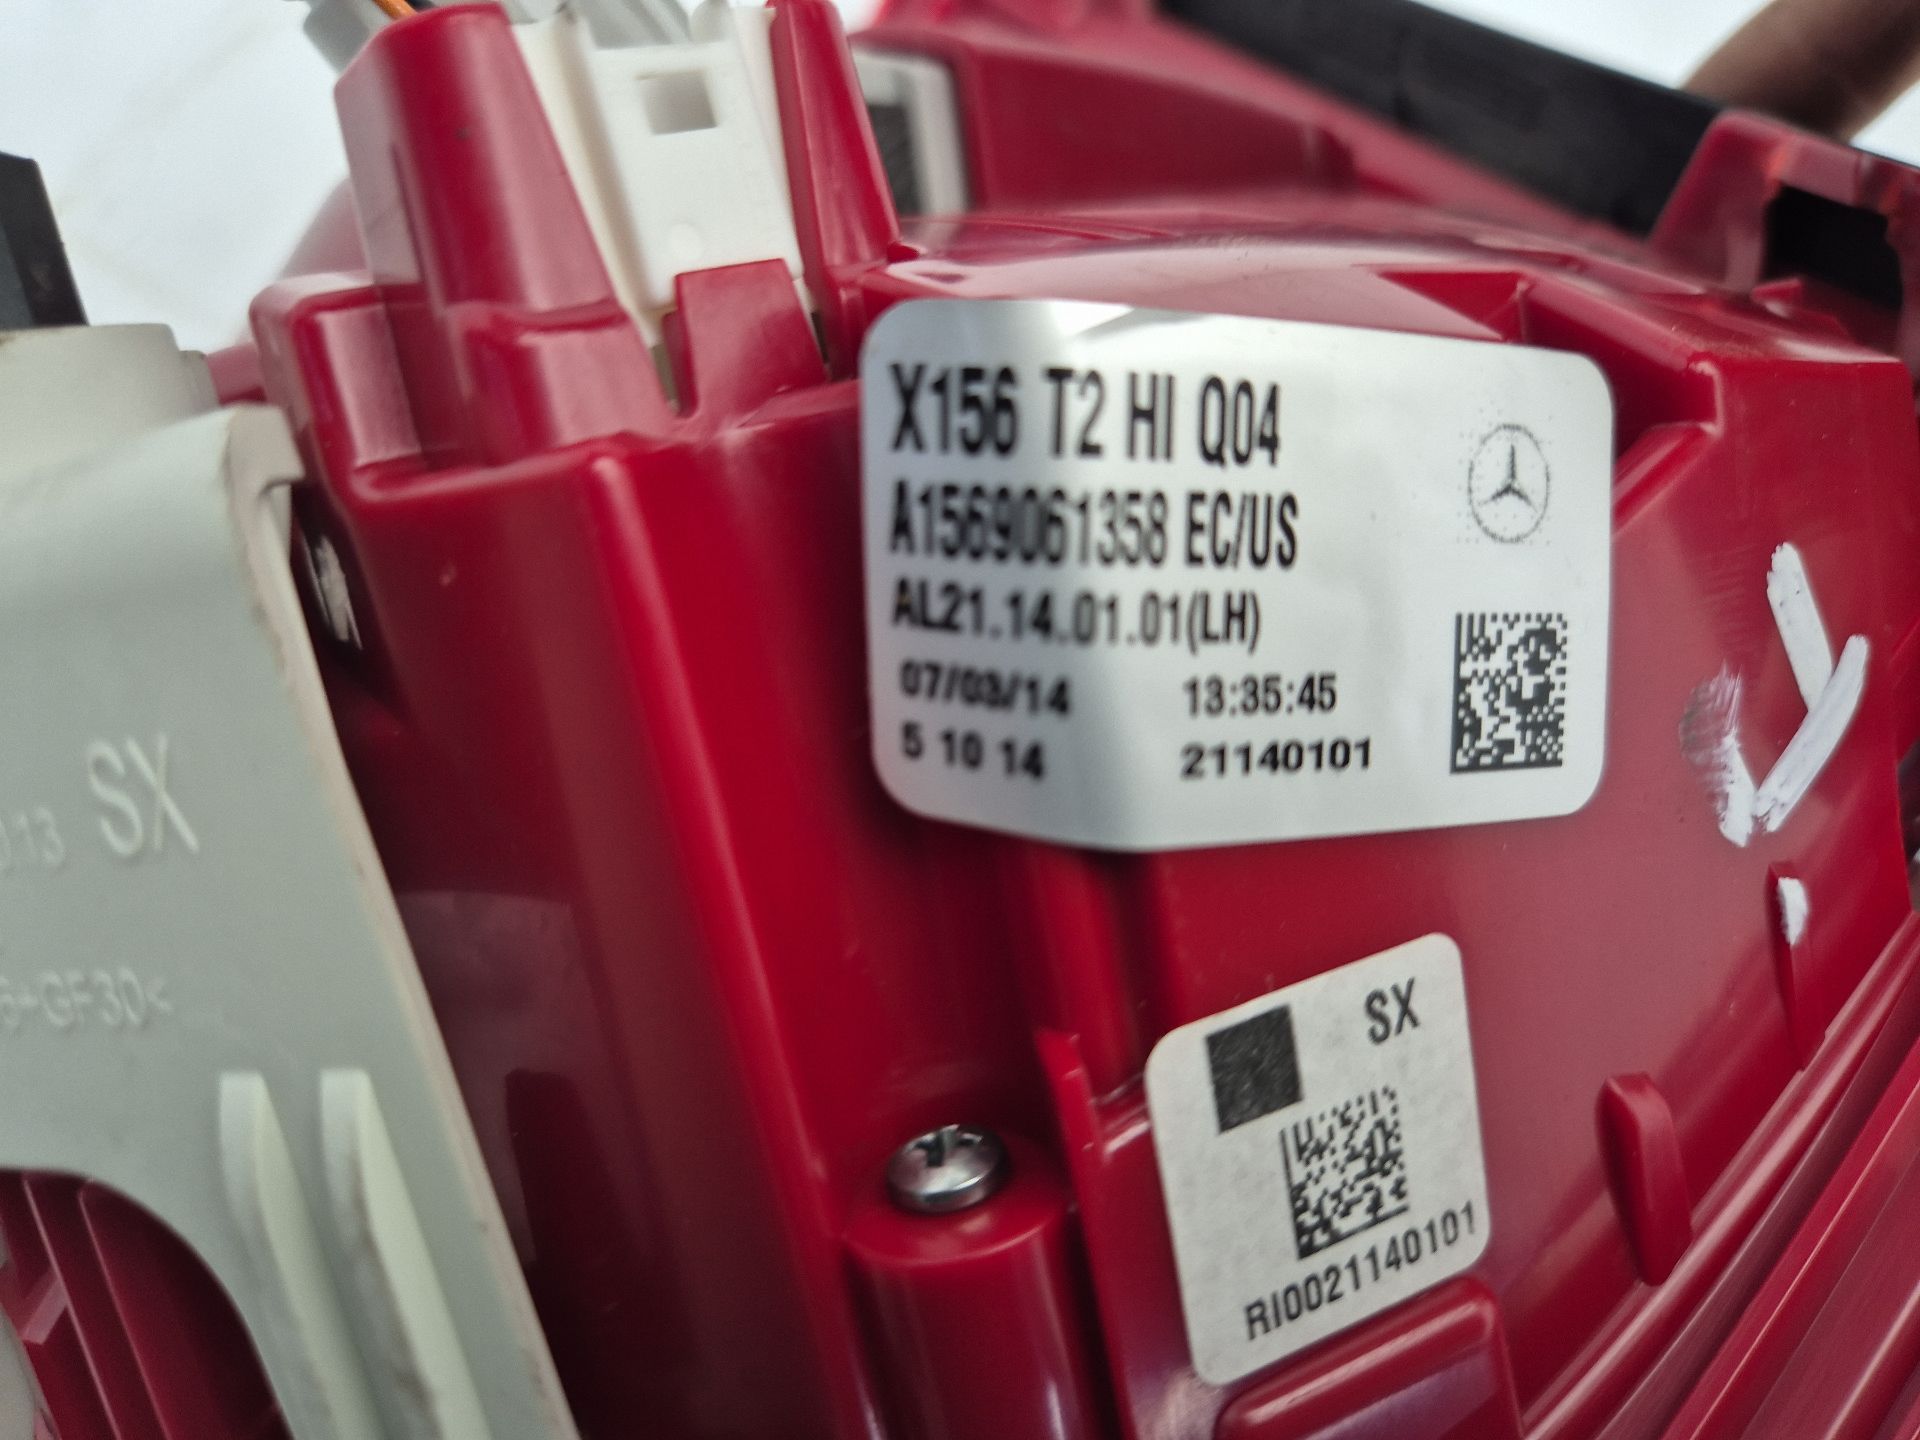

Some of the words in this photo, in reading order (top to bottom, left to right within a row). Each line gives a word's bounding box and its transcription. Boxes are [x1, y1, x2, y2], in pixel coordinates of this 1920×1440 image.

[890, 363, 1019, 456] X156
[1043, 367, 1104, 458] T2
[1127, 372, 1175, 461] HI
[1200, 375, 1280, 466] Q04
[889, 480, 1168, 567] A1569061358
[1185, 491, 1298, 568] EC/US
[893, 578, 1260, 653] AL21.14.01.01(LH)
[1185, 672, 1338, 717] 13:35:45
[902, 722, 923, 759] 5
[942, 729, 983, 768] 10
[1002, 738, 1046, 780] 14
[1181, 737, 1372, 779] 21140101
[86, 732, 198, 856] SX
[1364, 977, 1420, 1045] SX
[1244, 1199, 1476, 1342] RI0021140101
